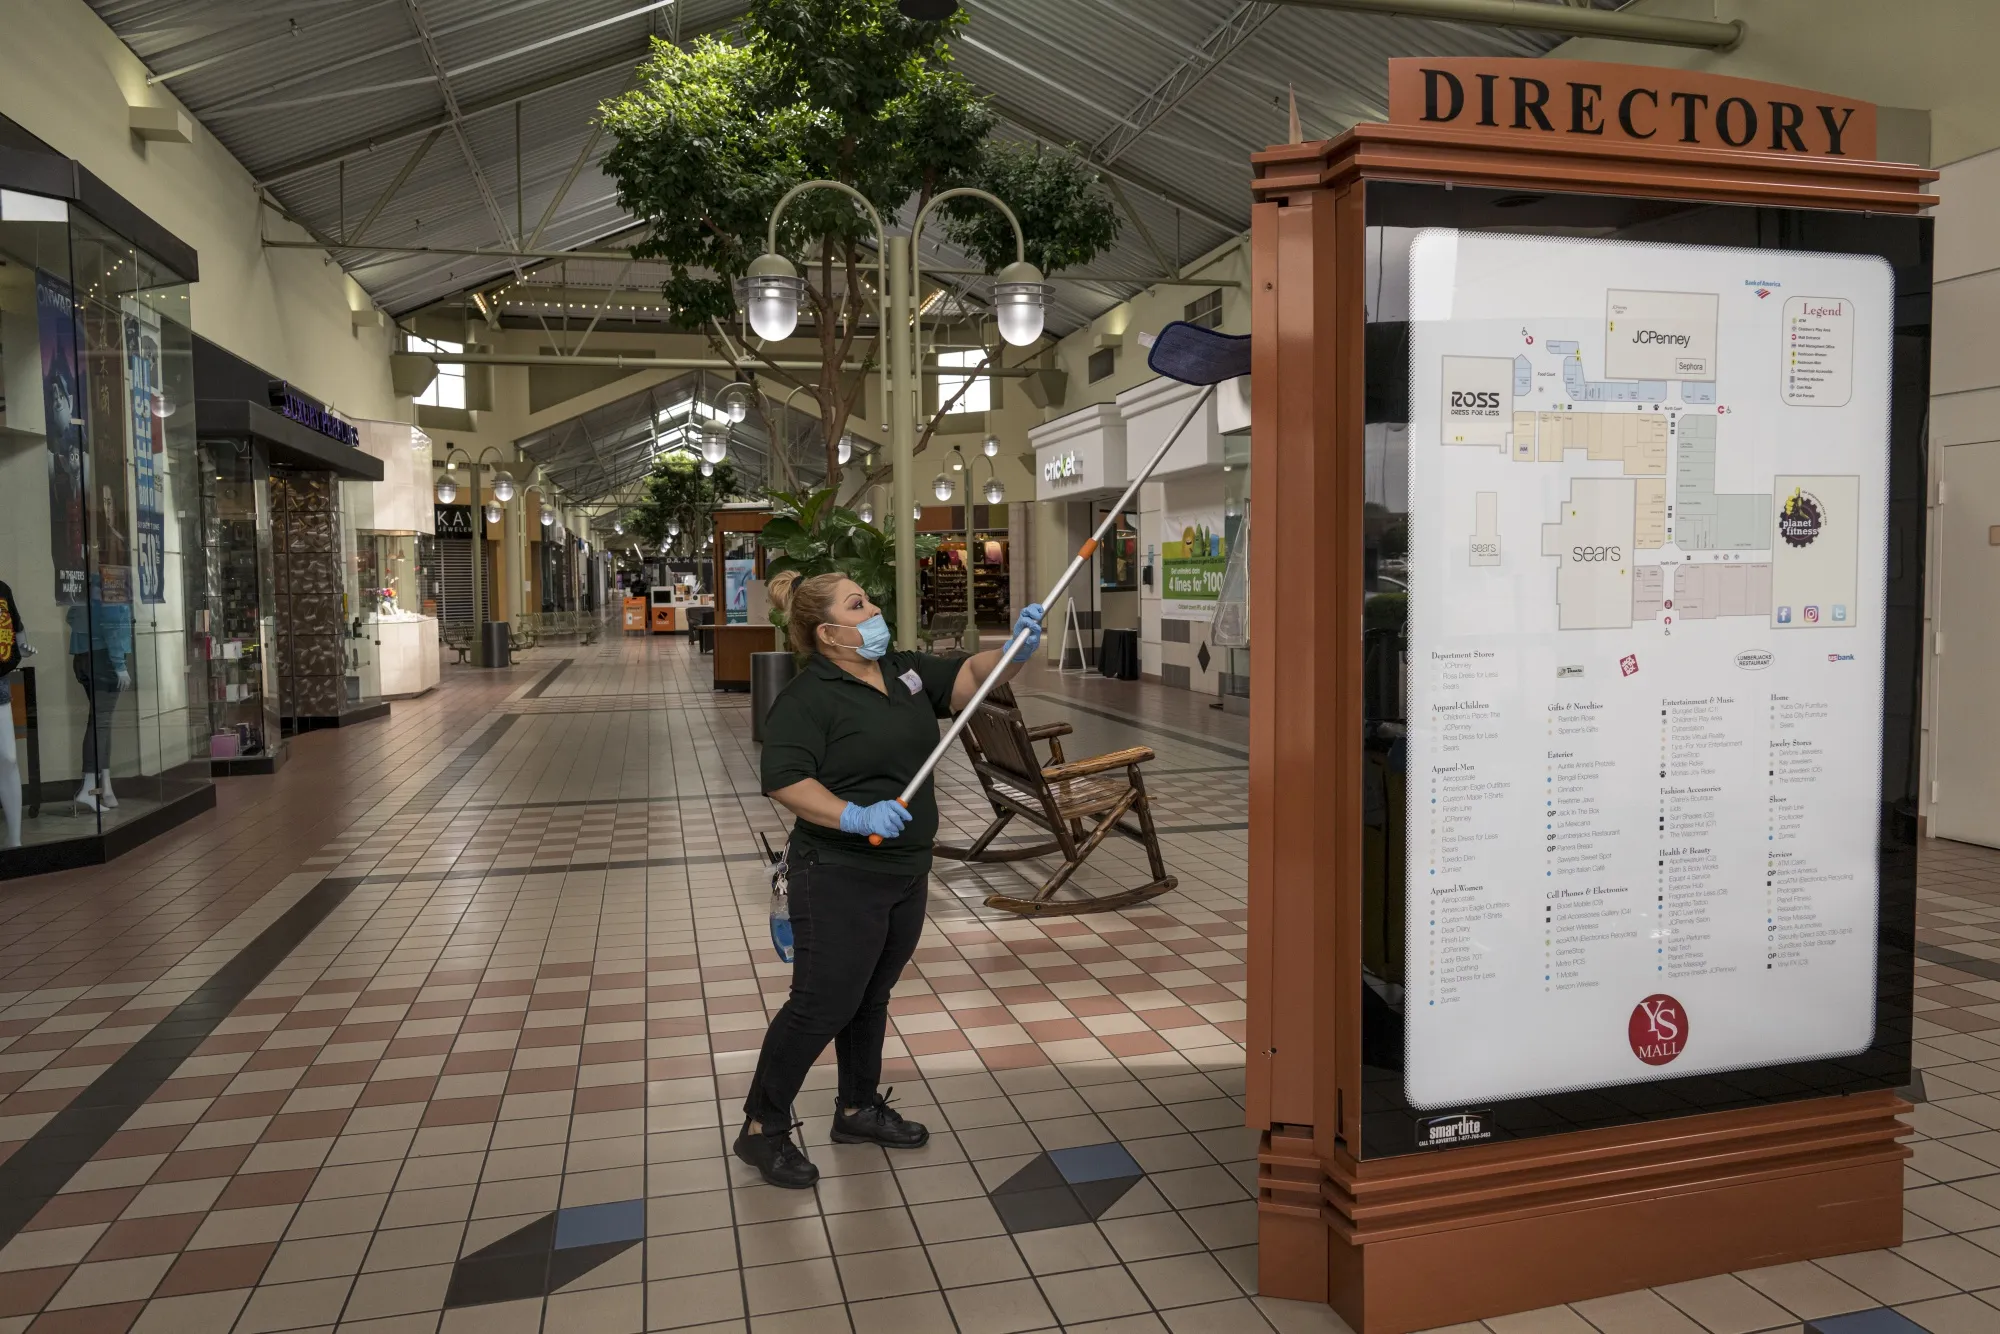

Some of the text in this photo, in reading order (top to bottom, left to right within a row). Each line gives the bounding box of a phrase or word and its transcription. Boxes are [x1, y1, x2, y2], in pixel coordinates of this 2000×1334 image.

[1419, 68, 1855, 155] DIRECTORY
[37, 284, 72, 318] ONWAR
[1803, 303, 1842, 318] Legend
[1632, 330, 1691, 348] JCPenney
[1679, 362, 1703, 371] Sephora
[133, 356, 150, 392] ALL
[283, 380, 319, 430] LUXURY
[1451, 391, 1500, 408] ROSS
[135, 396, 153, 480] TEES
[1044, 451, 1076, 482] cricket
[1783, 519, 1811, 529] planet
[1786, 527, 1817, 535] fitness
[1472, 544, 1496, 552] sears
[1572, 546, 1621, 562] sears
[138, 530, 158, 595] 50
[60, 570, 84, 580] IN THEATERS
[1169, 570, 1223, 592] 4 lines for $100
[63, 584, 81, 592] MARCH 6
[1432, 652, 1472, 660] Department
[1432, 701, 1489, 712] Apparel-Children
[1548, 704, 1564, 712] Gifts
[1574, 701, 1603, 710] Novelties
[1558, 727, 1585, 735] Spencer's
[1770, 739, 1790, 748] Jewelry
[1432, 763, 1474, 774] Apparel-Men
[1769, 795, 1787, 803] Shoes
[1557, 832, 1591, 840] Lumberjacks
[1546, 890, 1559, 899] Cell
[1561, 890, 1584, 898] Phones
[1593, 886, 1628, 894] Electronics
[1639, 1000, 1678, 1041] YS
[1639, 1042, 1680, 1059] MALL
[1430, 1115, 1480, 1139] smartlite
